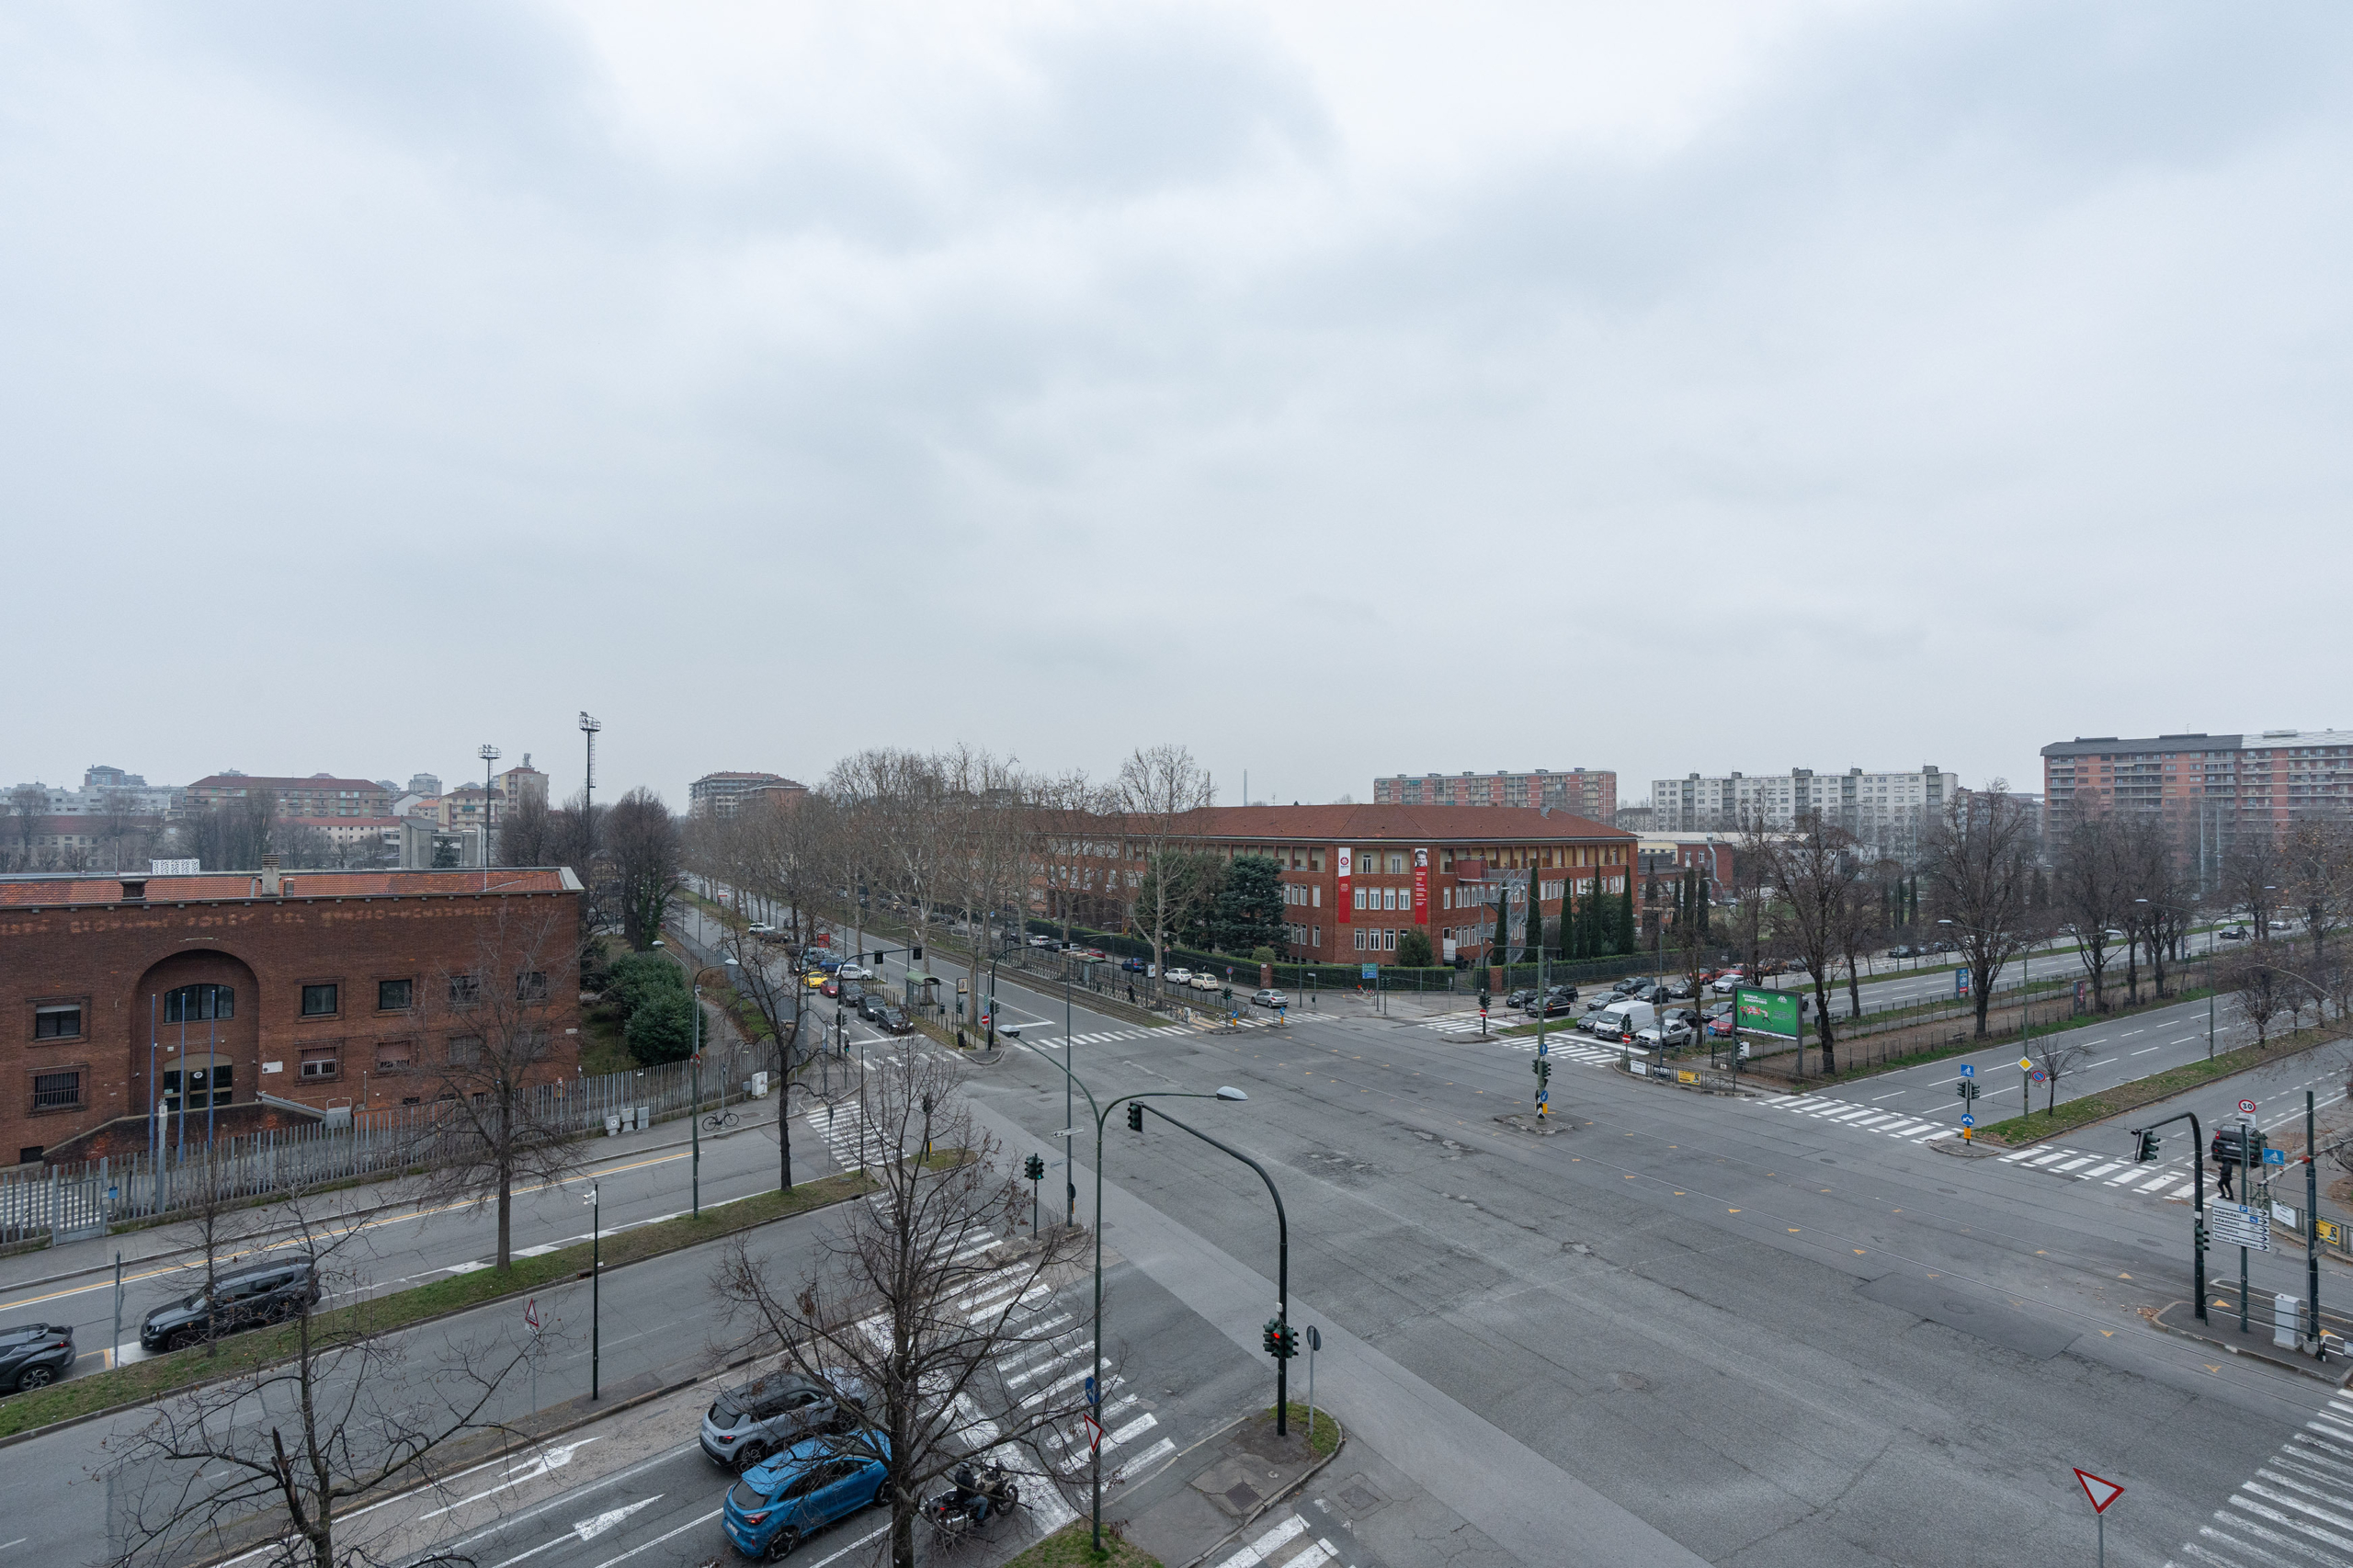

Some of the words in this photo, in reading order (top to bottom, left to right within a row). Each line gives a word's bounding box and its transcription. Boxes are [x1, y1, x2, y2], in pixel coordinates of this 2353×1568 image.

[2214, 1210, 2241, 1219] ospedali
[2215, 1218, 2240, 1226] stazioni
[2214, 1225, 2239, 1234] Olimpico
[2231, 1238, 2258, 1247] esposizioni
